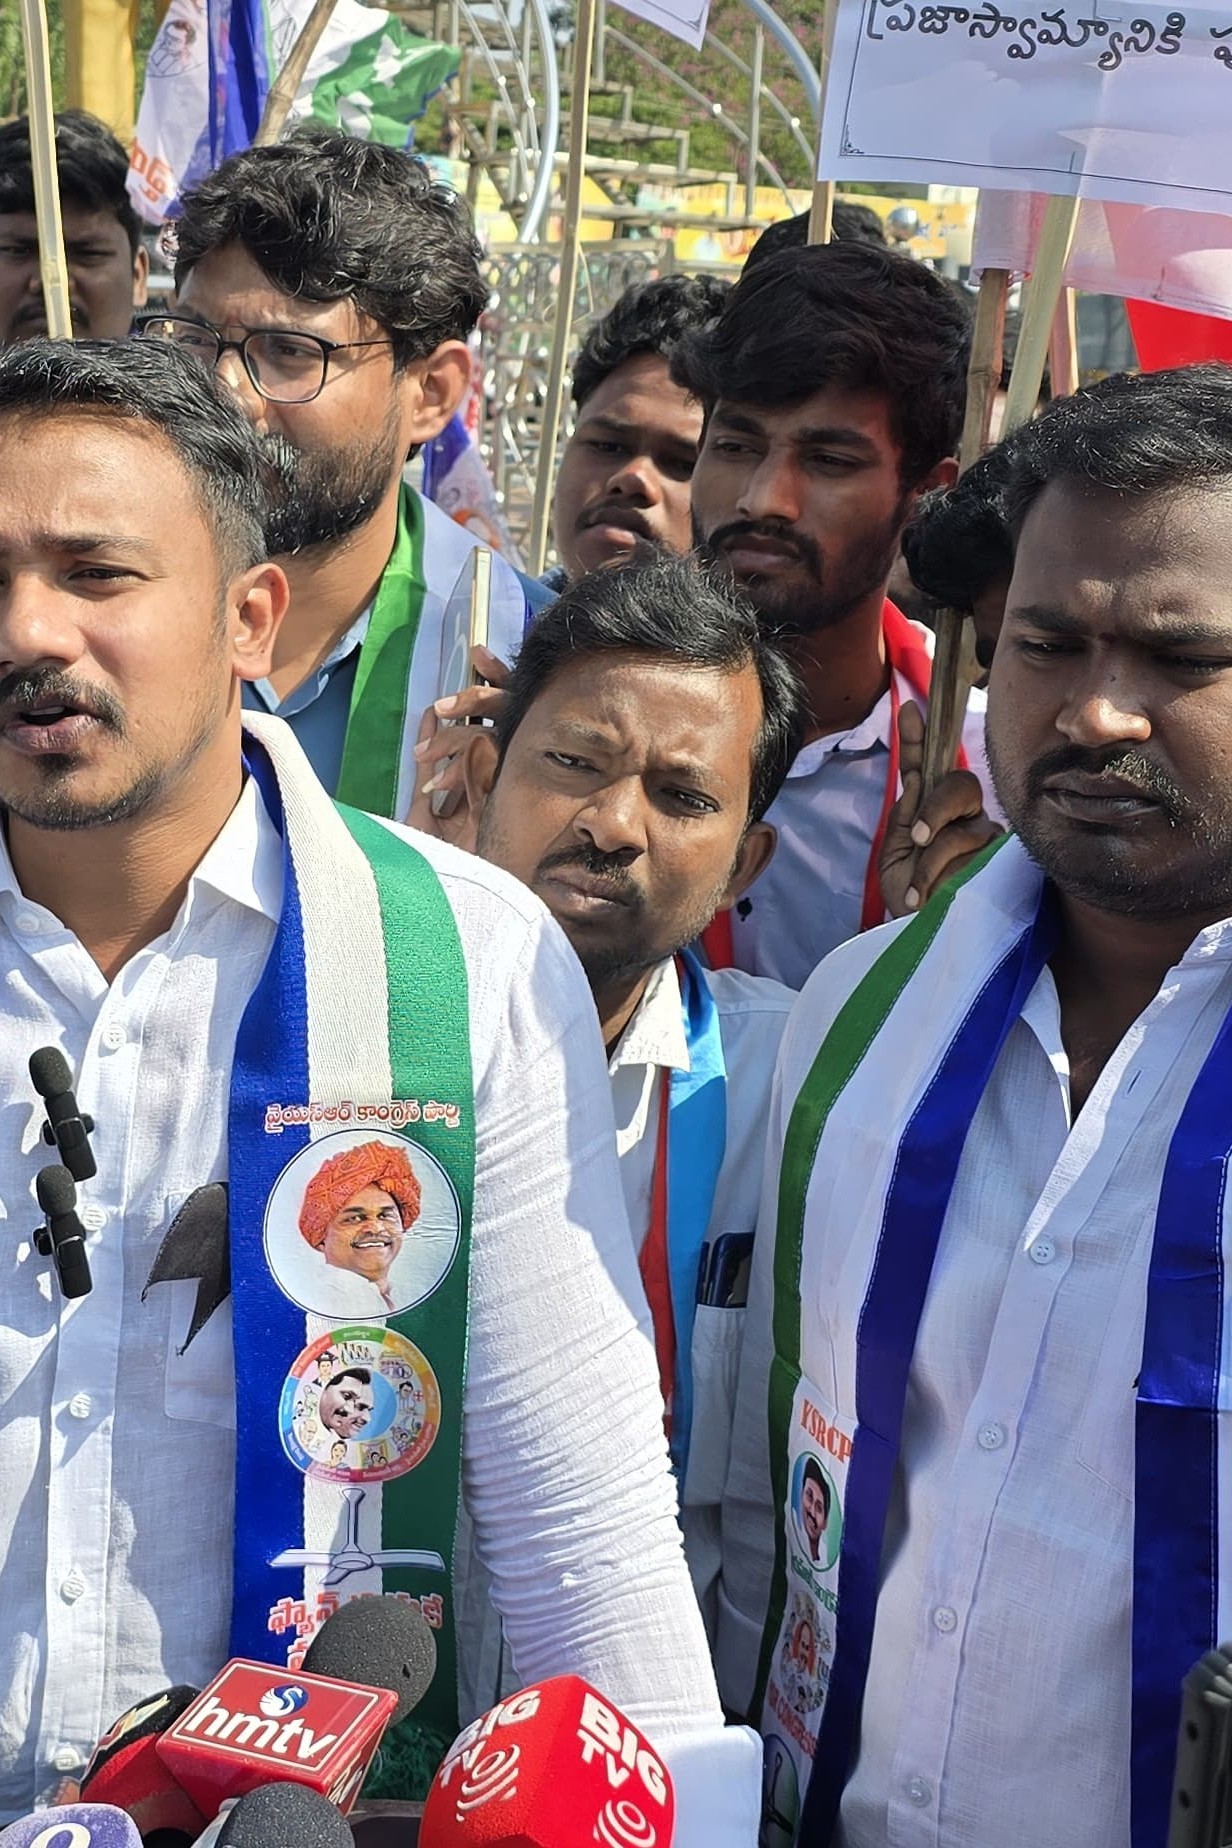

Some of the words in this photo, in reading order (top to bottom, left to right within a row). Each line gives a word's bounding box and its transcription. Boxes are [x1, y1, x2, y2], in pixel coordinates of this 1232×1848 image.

[356, 1101, 420, 1128] కాంగ్రెస్
[799, 1398, 854, 1464] YSRCP
[185, 1697, 338, 1759] hmtv
[442, 1690, 541, 1766] BIG
[577, 1728, 630, 1788] TV
[580, 1692, 668, 1806] BIG
[438, 1741, 486, 1788] TV
